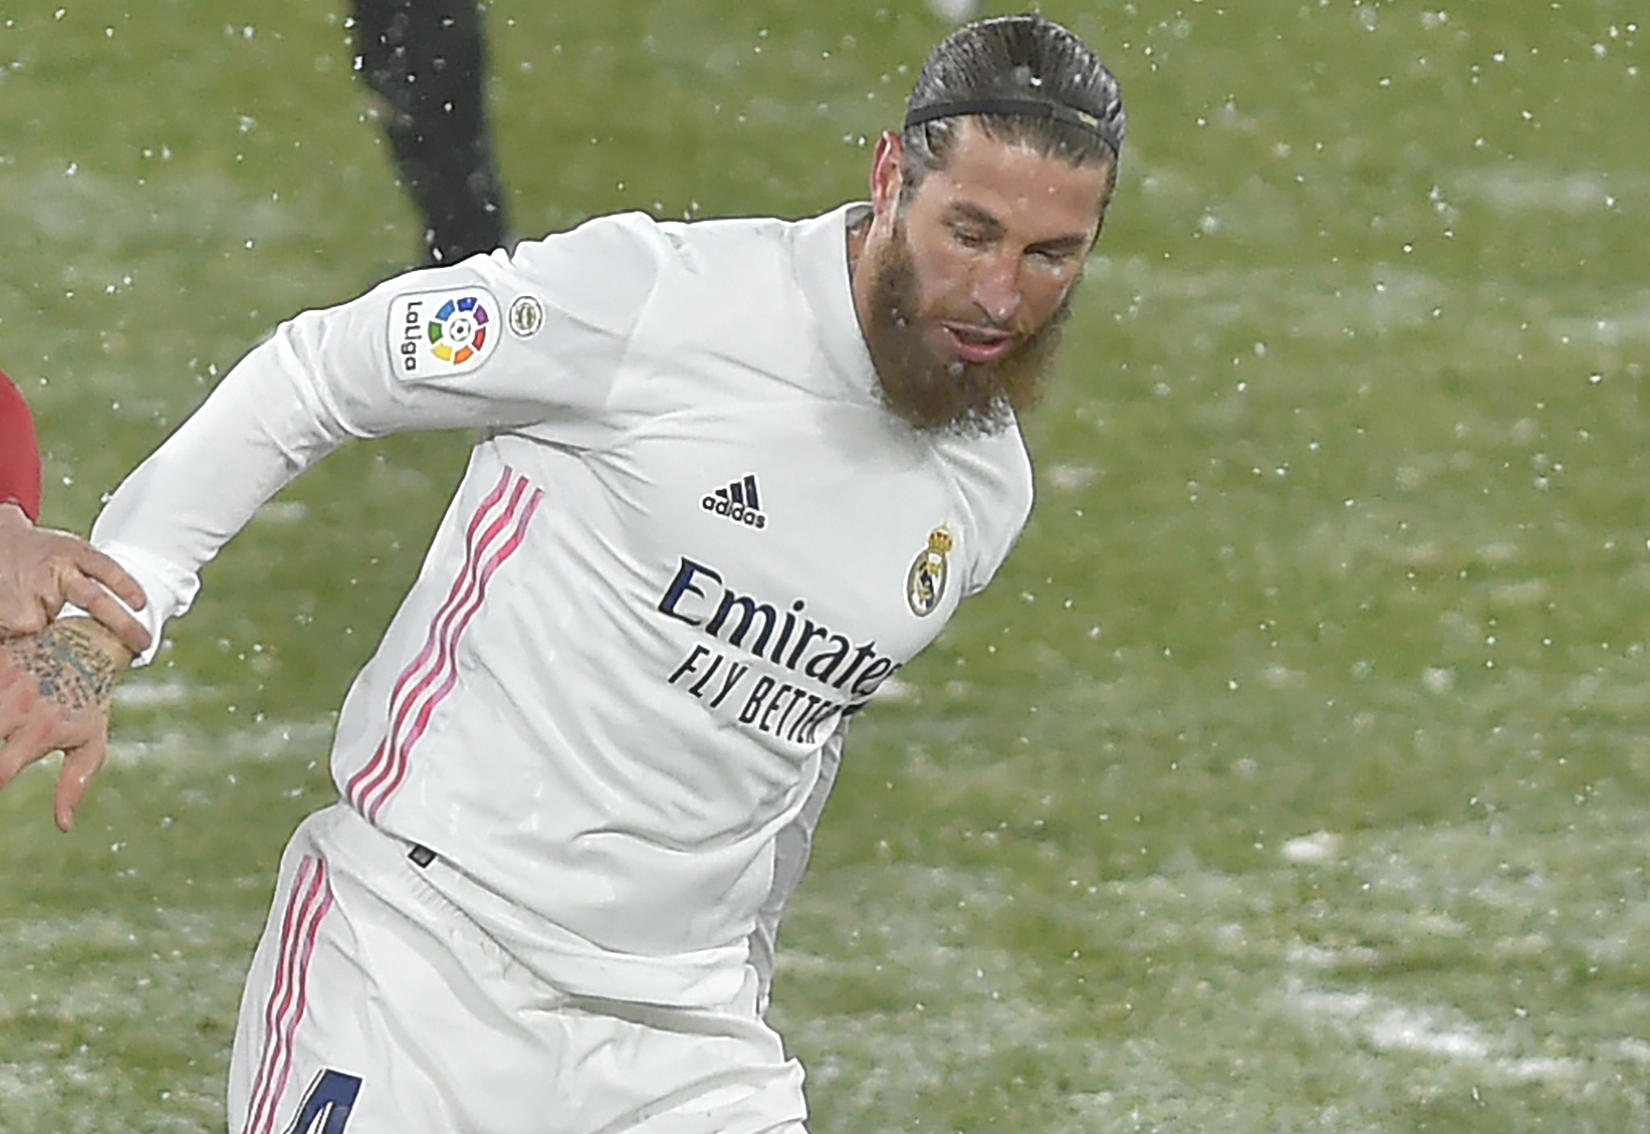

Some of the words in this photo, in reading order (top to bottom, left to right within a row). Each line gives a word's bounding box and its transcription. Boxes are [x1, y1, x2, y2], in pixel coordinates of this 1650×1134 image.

[401, 301, 423, 371] LaLiga
[701, 495, 766, 529] adidas
[668, 644, 749, 709] FLY
